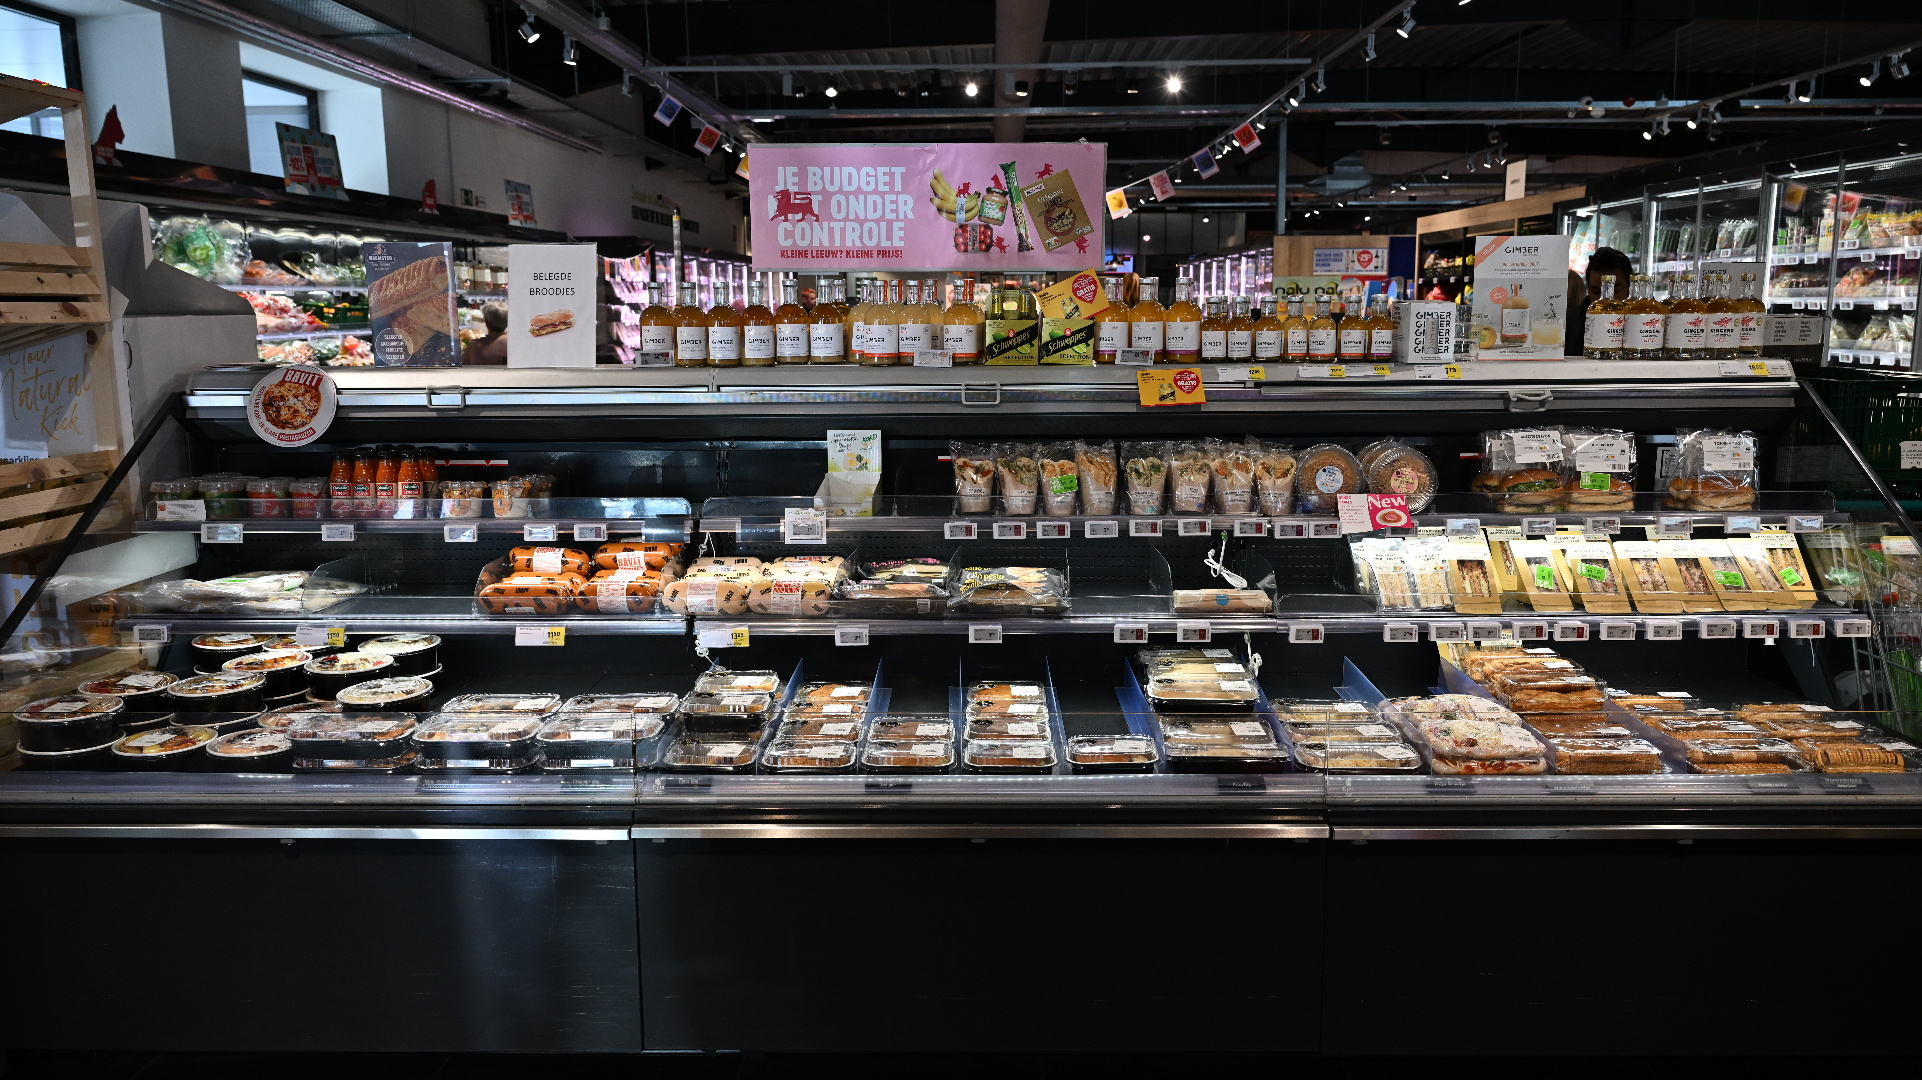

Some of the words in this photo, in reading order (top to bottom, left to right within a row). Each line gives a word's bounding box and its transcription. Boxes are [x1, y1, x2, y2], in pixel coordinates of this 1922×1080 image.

[774, 166, 799, 192] JE
[807, 166, 906, 192] BUDGET
[830, 194, 915, 220] ONDER
[777, 221, 905, 247] CONTROLE
[780, 249, 809, 258] KLEINE
[810, 249, 844, 258] LEEUW?
[845, 249, 874, 258] KLEINE
[876, 249, 903, 259] PRIJS!
[1504, 246, 1539, 254] GIMBER
[533, 272, 572, 281] BELEGDE
[529, 287, 576, 296] BROODJES
[1415, 311, 1452, 320] GIMBER
[992, 329, 1032, 356] Schweppes
[1048, 329, 1088, 355] Schweppes
[285, 369, 320, 387] BAVET
[41, 403, 83, 440] Kick
[1367, 495, 1406, 510] New
[983, 573, 1005, 582] pesto
